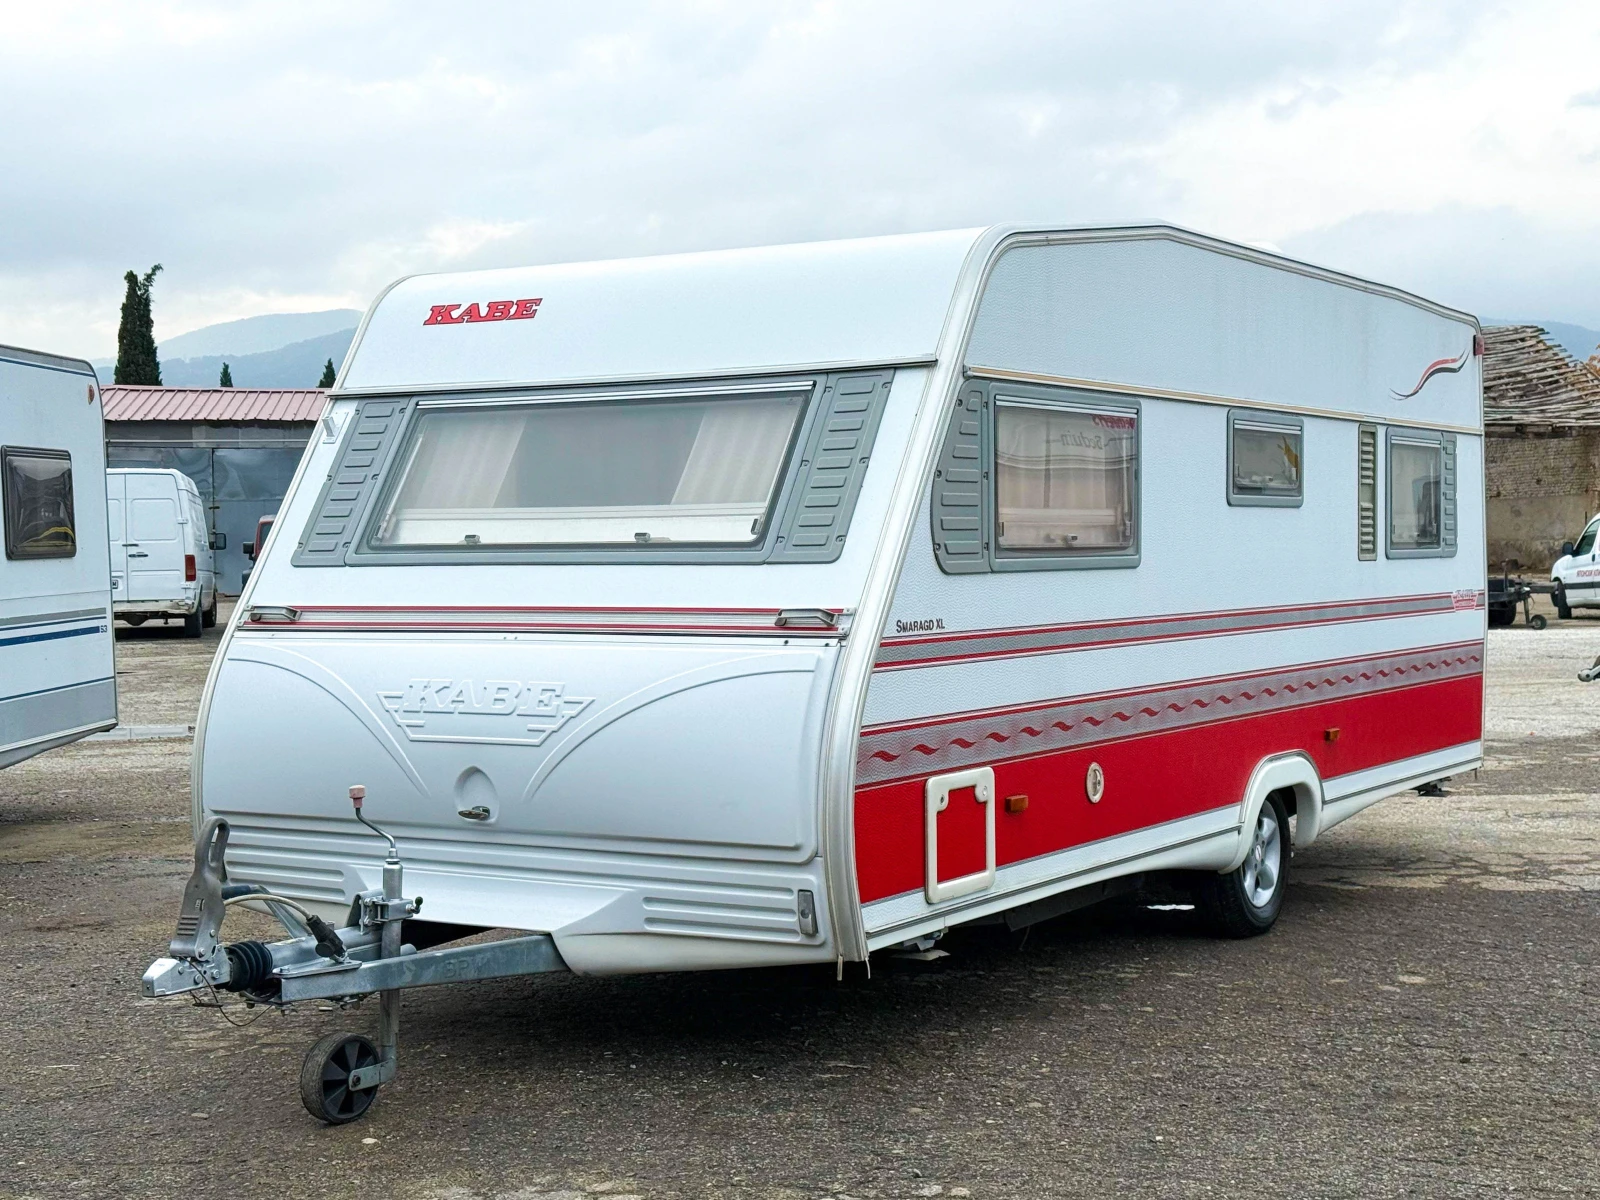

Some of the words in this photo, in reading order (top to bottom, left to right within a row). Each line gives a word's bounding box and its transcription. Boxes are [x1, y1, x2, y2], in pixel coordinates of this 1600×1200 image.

[423, 298, 543, 325] KABE
[896, 619, 934, 633] SMARAGD
[935, 618, 946, 630] XL
[402, 678, 566, 717] KABE
